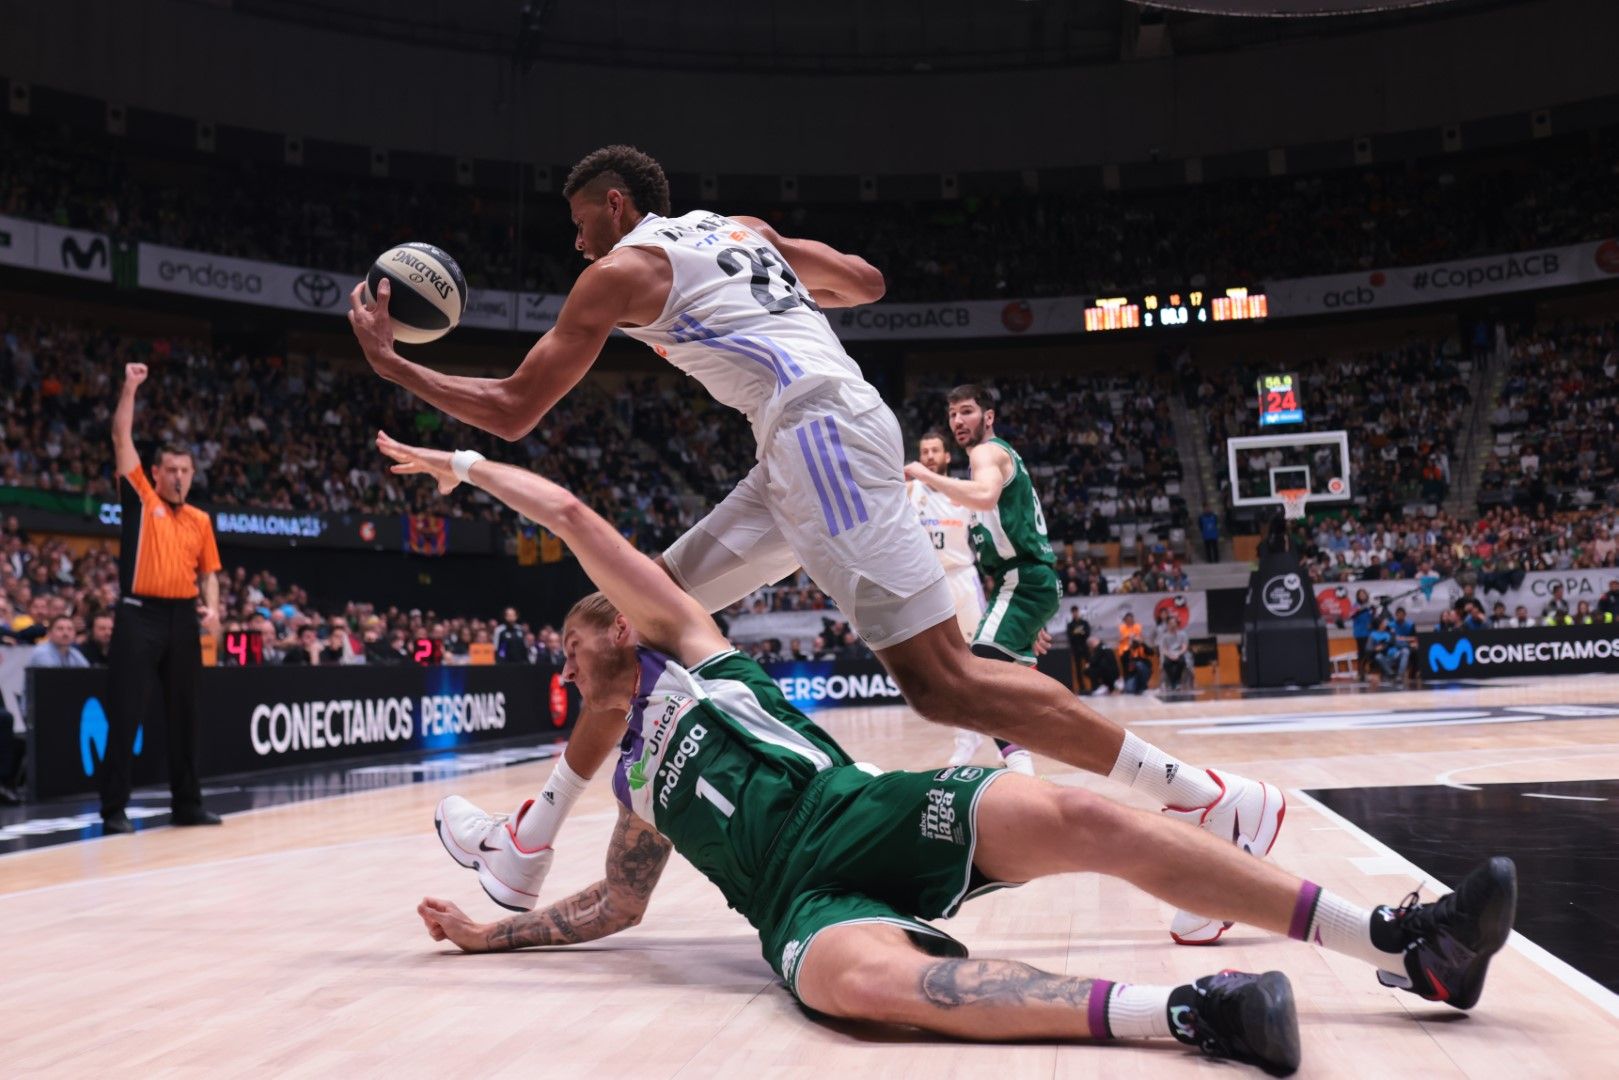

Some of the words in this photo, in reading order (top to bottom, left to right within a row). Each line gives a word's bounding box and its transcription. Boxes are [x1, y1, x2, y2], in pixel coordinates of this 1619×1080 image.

[158, 260, 262, 294] endesa
[391, 249, 454, 300] SPALDING
[1412, 253, 1560, 290] #CopaACB
[1323, 286, 1375, 308] acb
[840, 308, 971, 332] #CopaACB
[1266, 390, 1297, 413] 24
[226, 633, 248, 666] 4
[414, 639, 433, 666] 2
[780, 673, 901, 701] ERSONAS
[250, 697, 413, 755] CONECTAMOS
[420, 692, 505, 737] PERSONAS
[695, 775, 736, 818] 1
